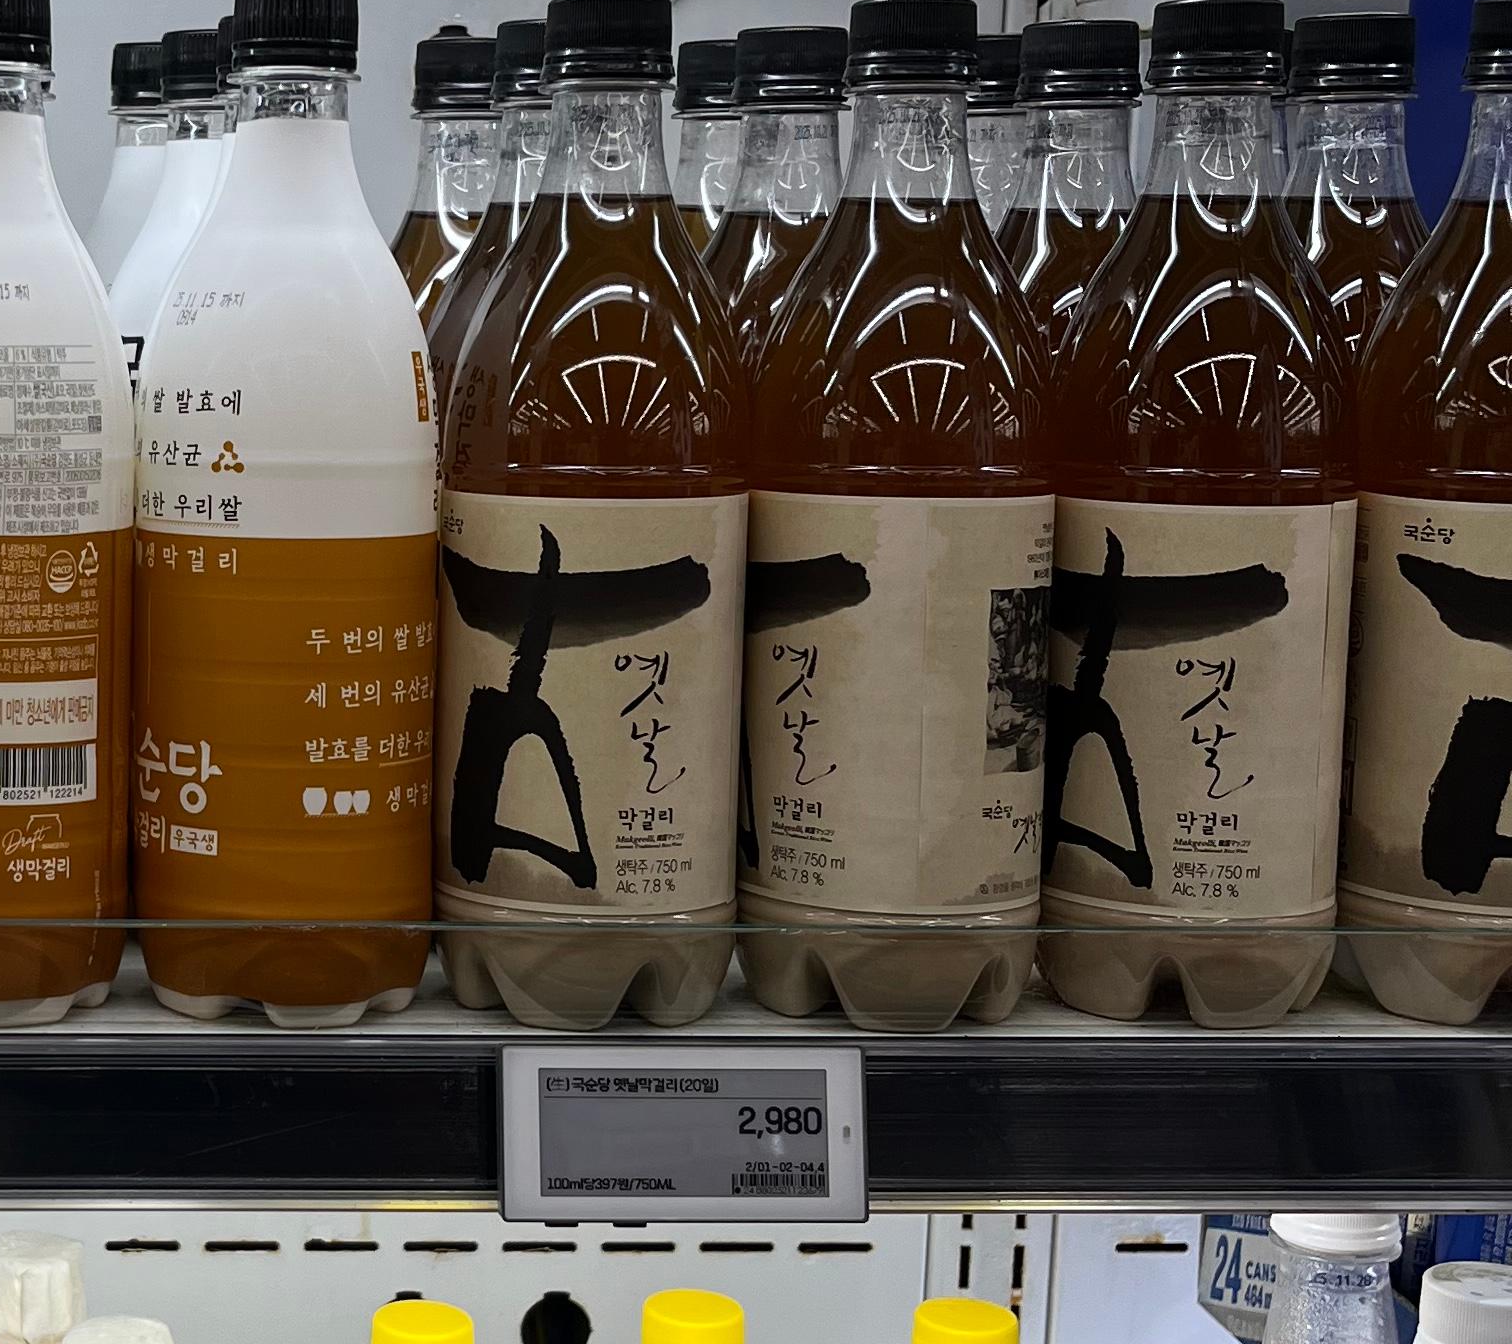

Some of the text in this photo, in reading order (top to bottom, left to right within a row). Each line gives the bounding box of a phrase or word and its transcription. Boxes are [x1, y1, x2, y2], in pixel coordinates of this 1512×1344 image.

[1403, 518, 1456, 546] 국순당
[6, 698, 24, 726] 미만
[26, 696, 66, 726] 청소년에게
[617, 807, 675, 832] 막걸리
[1176, 811, 1239, 835] 막걸리
[1, 825, 53, 855] Draft
[7, 856, 70, 882] 생막걸리
[615, 857, 693, 877] 생탁주 750 ml
[738, 1106, 822, 1139] 2,980
[1210, 1234, 1243, 1304] 24
[1245, 1261, 1277, 1283] CANS
